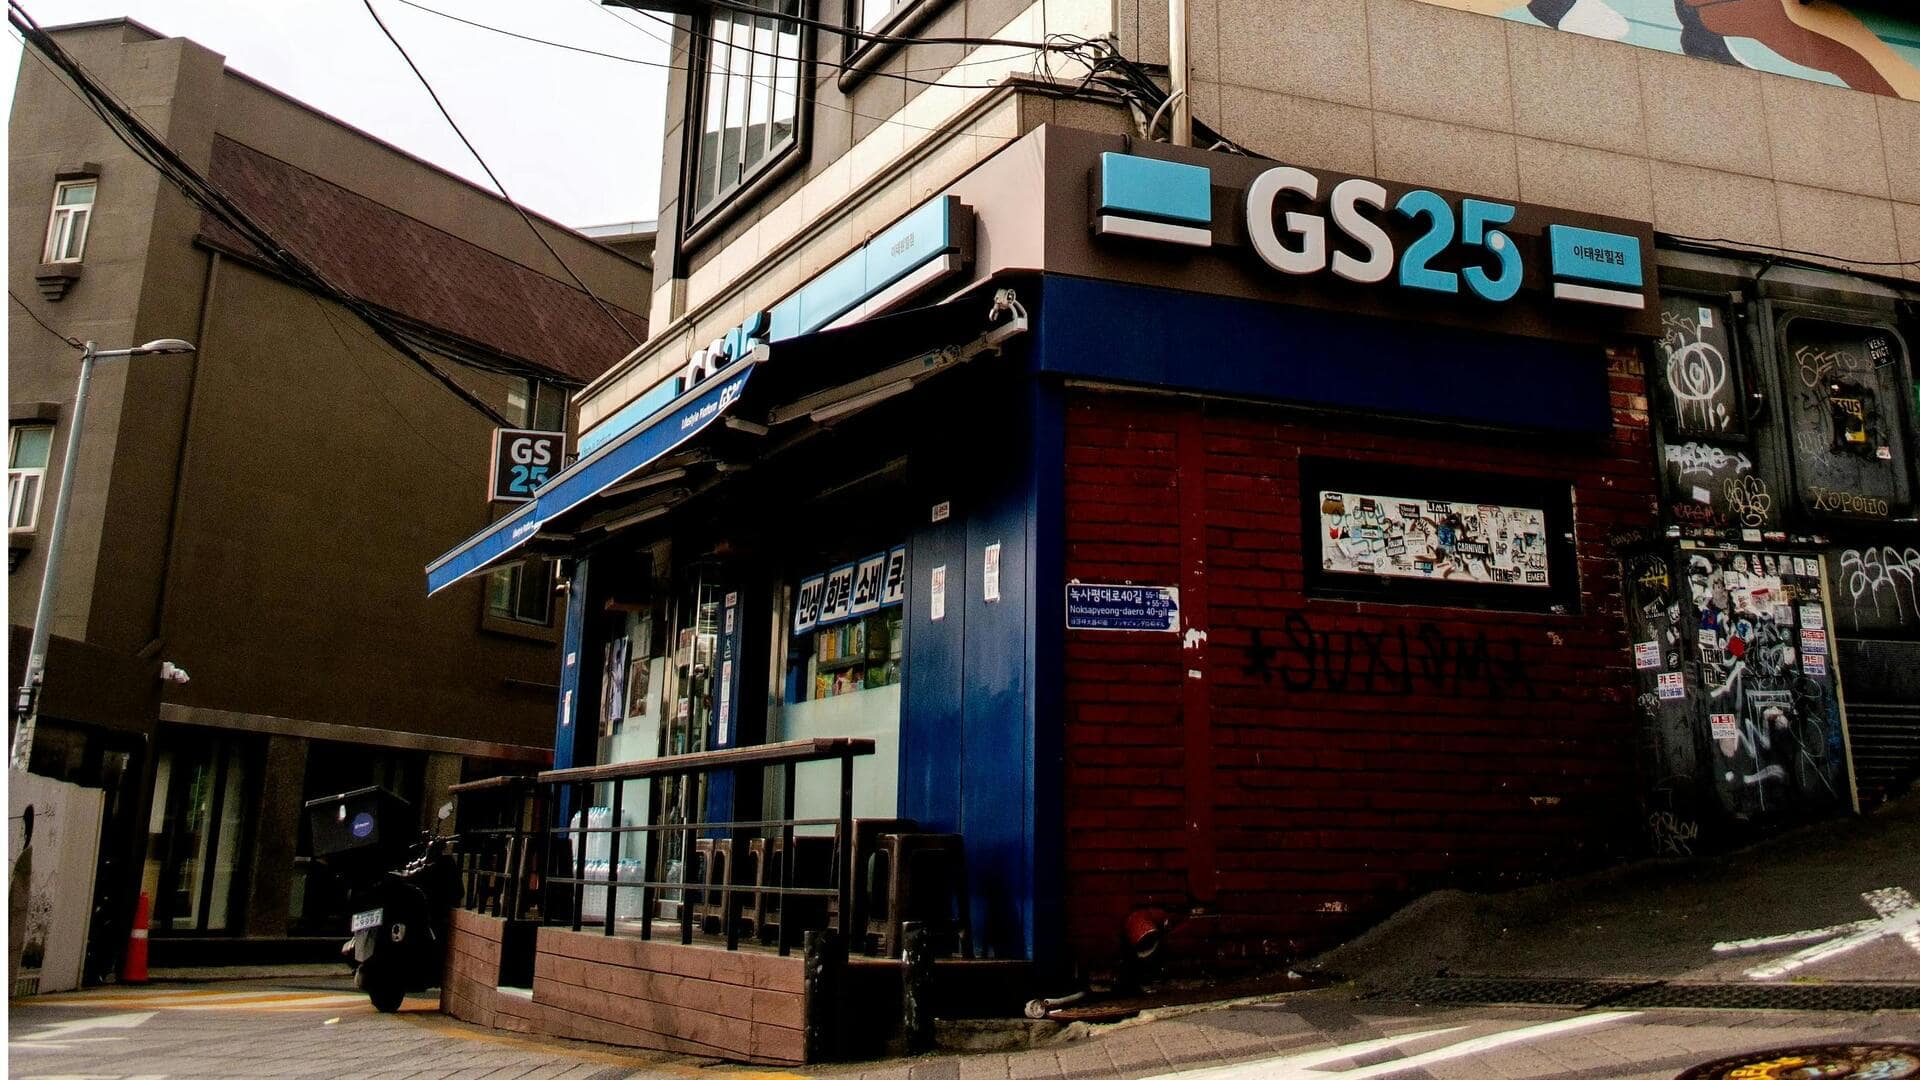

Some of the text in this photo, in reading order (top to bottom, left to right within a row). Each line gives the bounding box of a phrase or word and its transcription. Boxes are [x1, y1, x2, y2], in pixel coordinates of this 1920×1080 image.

[1246, 166, 1524, 302] GS25
[1573, 245, 1625, 266] 이태원힐점
[511, 437, 551, 465] GS
[509, 465, 549, 493] 25
[888, 555, 904, 597] 쿠
[1070, 588, 1142, 604] 녹사평대로40길
[1070, 605, 1168, 618] Noksapyeong-daero 40-gil
